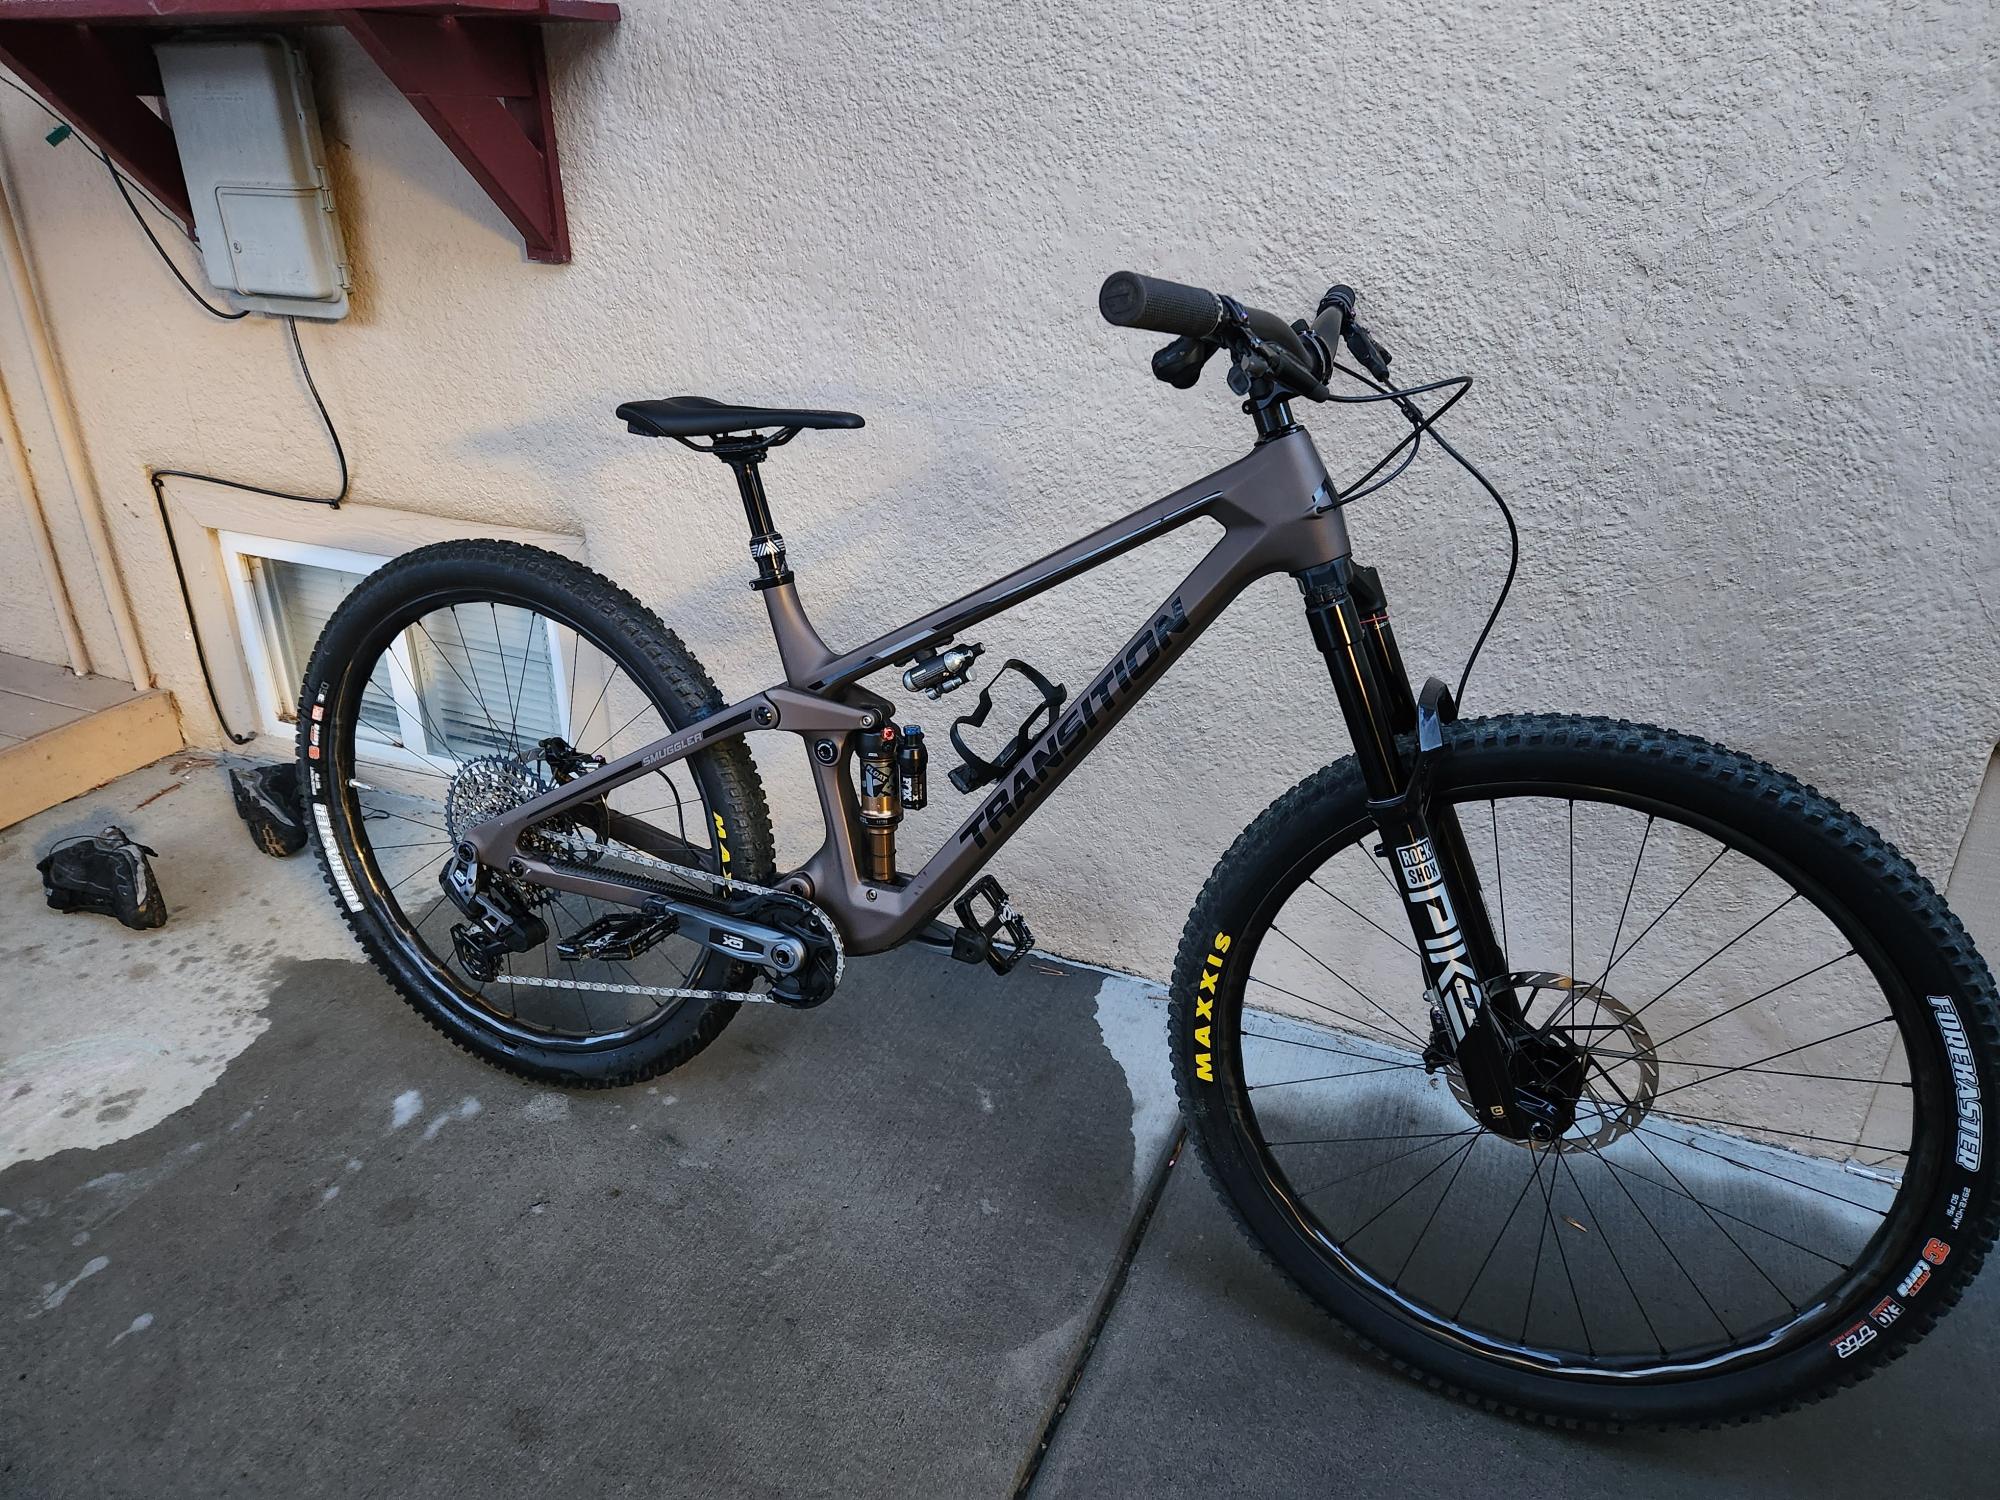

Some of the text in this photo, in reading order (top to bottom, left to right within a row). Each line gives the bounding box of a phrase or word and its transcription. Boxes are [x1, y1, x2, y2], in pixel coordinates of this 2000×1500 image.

[959, 596, 1190, 849] TRANSITION
[642, 732, 703, 767] SMUGGLER
[866, 764, 887, 782] FLOAT
[902, 776, 913, 802] FOX
[1400, 842, 1433, 867] ROCK
[1408, 862, 1438, 884] SHOX
[1408, 881, 1482, 1042] PIKE
[1194, 931, 1232, 1083] MAXXIS
[1927, 995, 1983, 1172] FOREKASTER
[1876, 1302, 1904, 1328] EXO
[1836, 1325, 1877, 1358] TR
